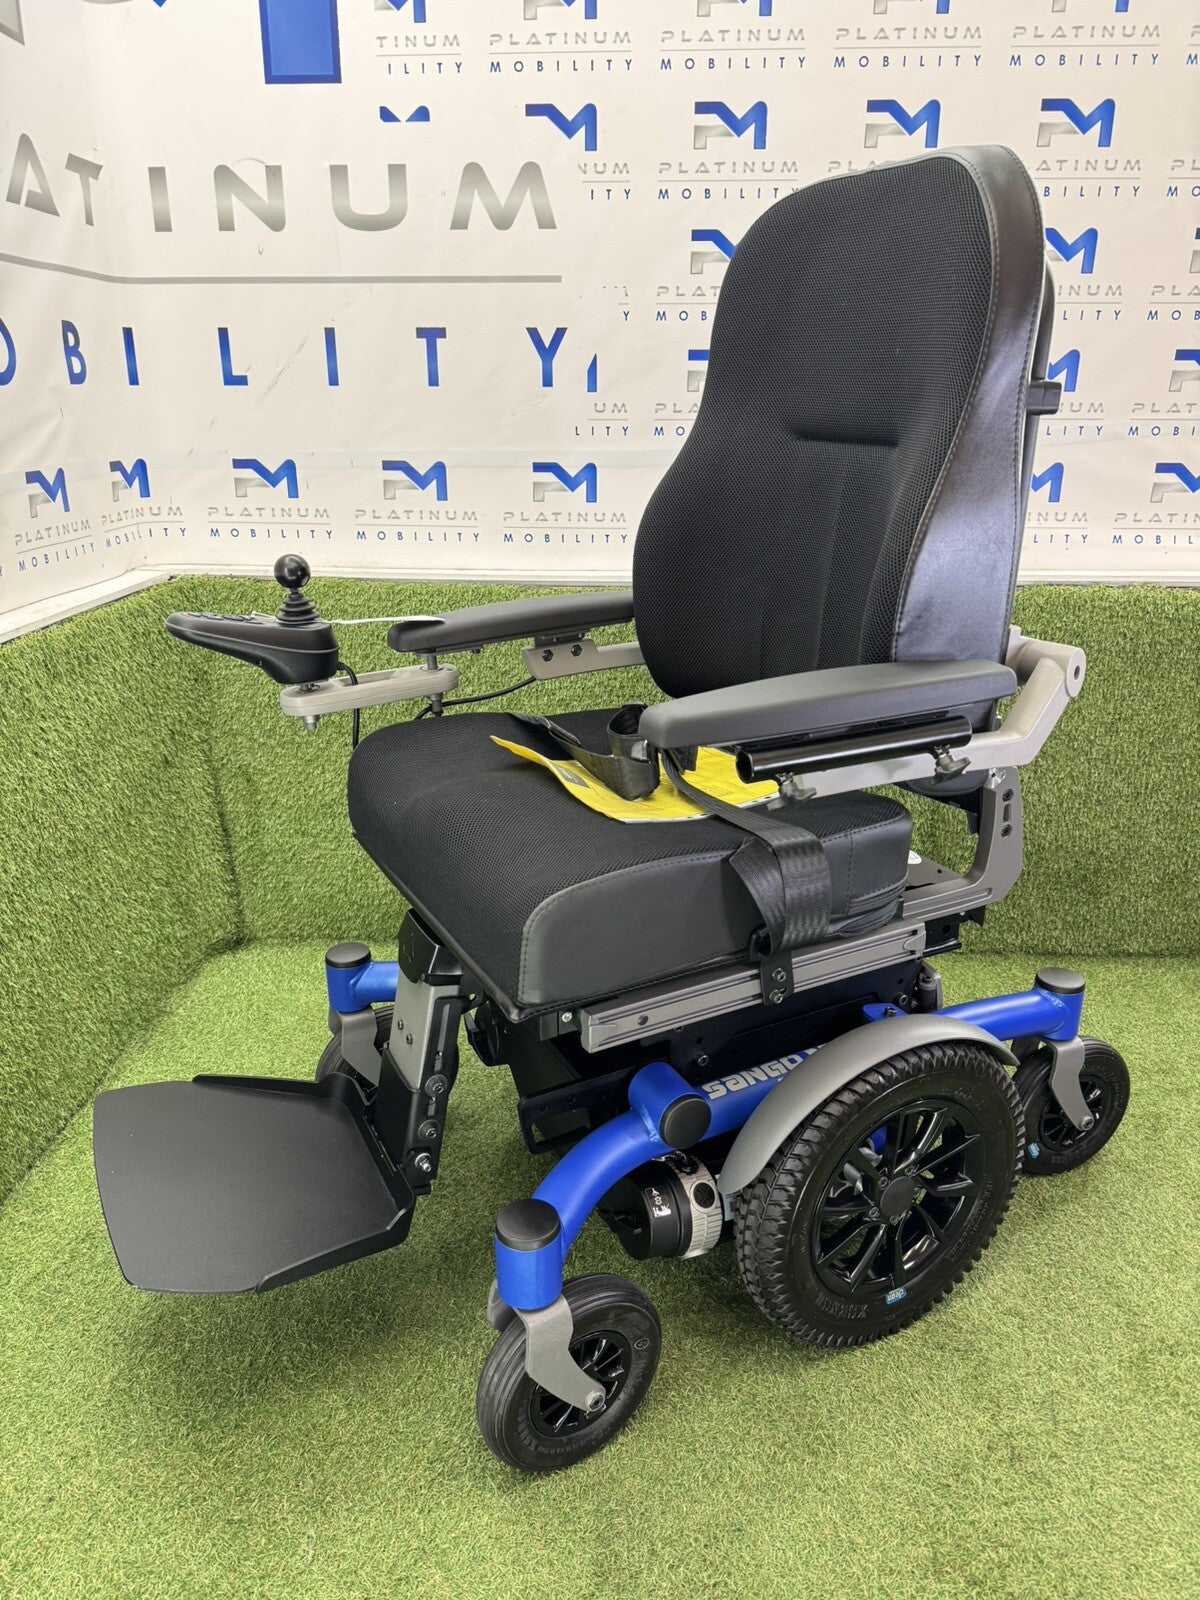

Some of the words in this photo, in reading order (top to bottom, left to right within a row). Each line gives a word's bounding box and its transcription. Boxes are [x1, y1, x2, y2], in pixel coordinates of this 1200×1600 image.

[662, 29, 805, 42] PLATINUM
[836, 27, 981, 40] PLATINUM
[1013, 25, 1160, 38] PLATINUM
[490, 31, 631, 45] PLATINUM
[660, 57, 805, 70] MOBILITY
[834, 55, 981, 68] MOBILITY
[1010, 54, 1159, 66] MOBILITY
[490, 59, 632, 73] MOBILITY
[659, 161, 798, 173] PLATINUM
[1036, 159, 1141, 171] ATINUM
[6, 133, 557, 232] ATINUM
[1044, 186, 1140, 197] BILITY
[1058, 285, 1122, 296] INUM
[1063, 310, 1121, 320] LITY
[1132, 403, 1197, 413] PLAT
[1046, 426, 1103, 435] LITY
[1128, 426, 1195, 436] MOBI
[101, 507, 183, 525] PLATINUM
[208, 507, 329, 518] PLATINUM
[355, 509, 477, 520] PLATINUM
[503, 512, 626, 522] PLATINUM
[1028, 512, 1087, 522] INUM
[15, 519, 91, 546] PLATINUM
[106, 528, 186, 548] MOBILITY
[210, 528, 332, 539] MOBILITY
[357, 531, 479, 542] MOBILITY
[504, 533, 627, 543] MOBILITY
[1034, 534, 1088, 543] LITY
[1112, 535, 1193, 544] MOBIL
[18, 543, 95, 571] MOBILITY
